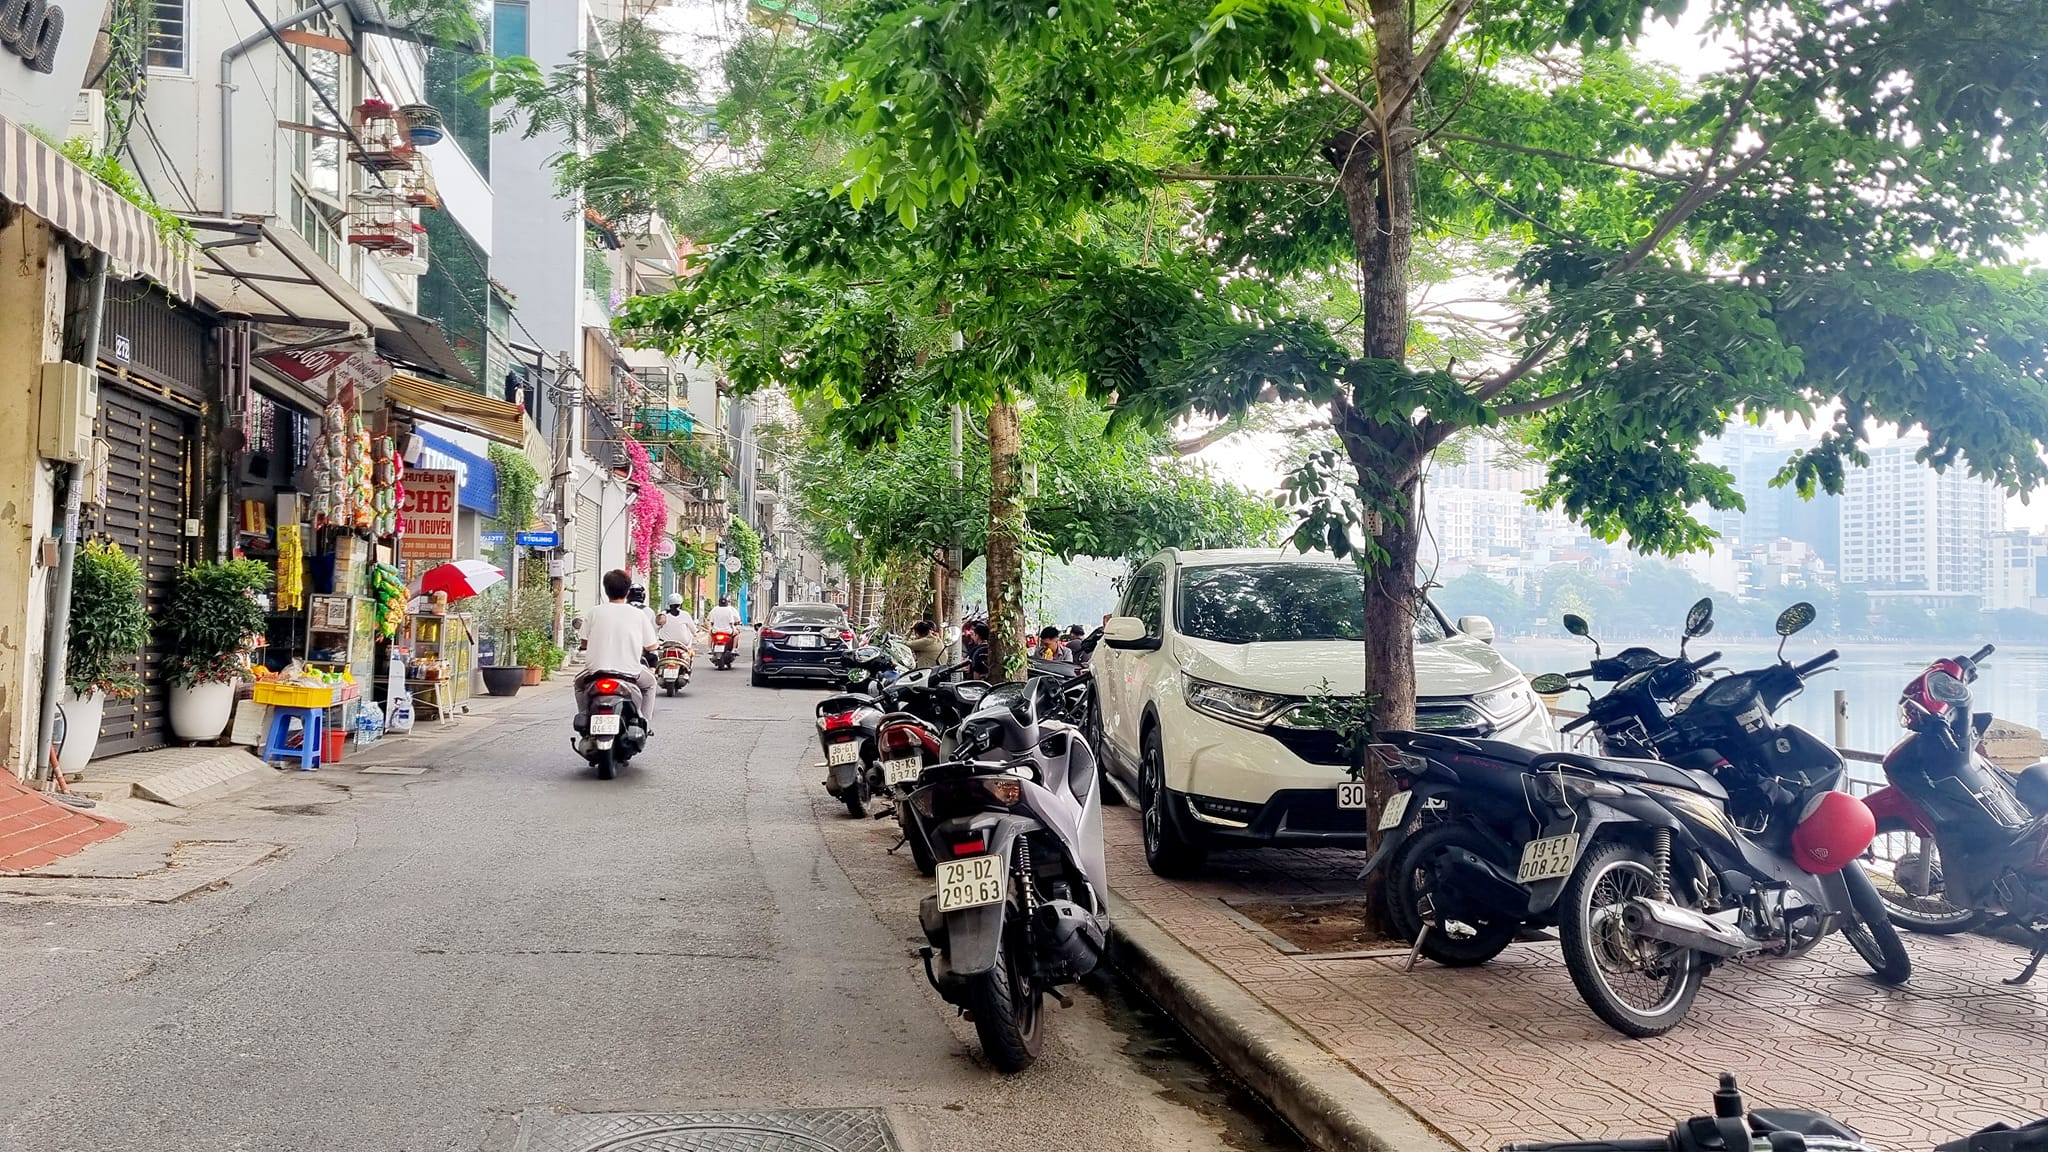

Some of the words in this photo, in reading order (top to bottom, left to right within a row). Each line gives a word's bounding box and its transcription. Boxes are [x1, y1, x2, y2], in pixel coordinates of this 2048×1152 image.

[117, 338, 130, 359] 272
[402, 486, 452, 514] CHÈ
[419, 517, 451, 536] NGUYÊN
[890, 758, 916, 772] 19-K9
[890, 768, 917, 783] 8378
[1532, 838, 1568, 859] 19-E1
[946, 859, 993, 885] 29-D2
[1521, 855, 1569, 879] 008.22
[942, 880, 1000, 908] 299.63
